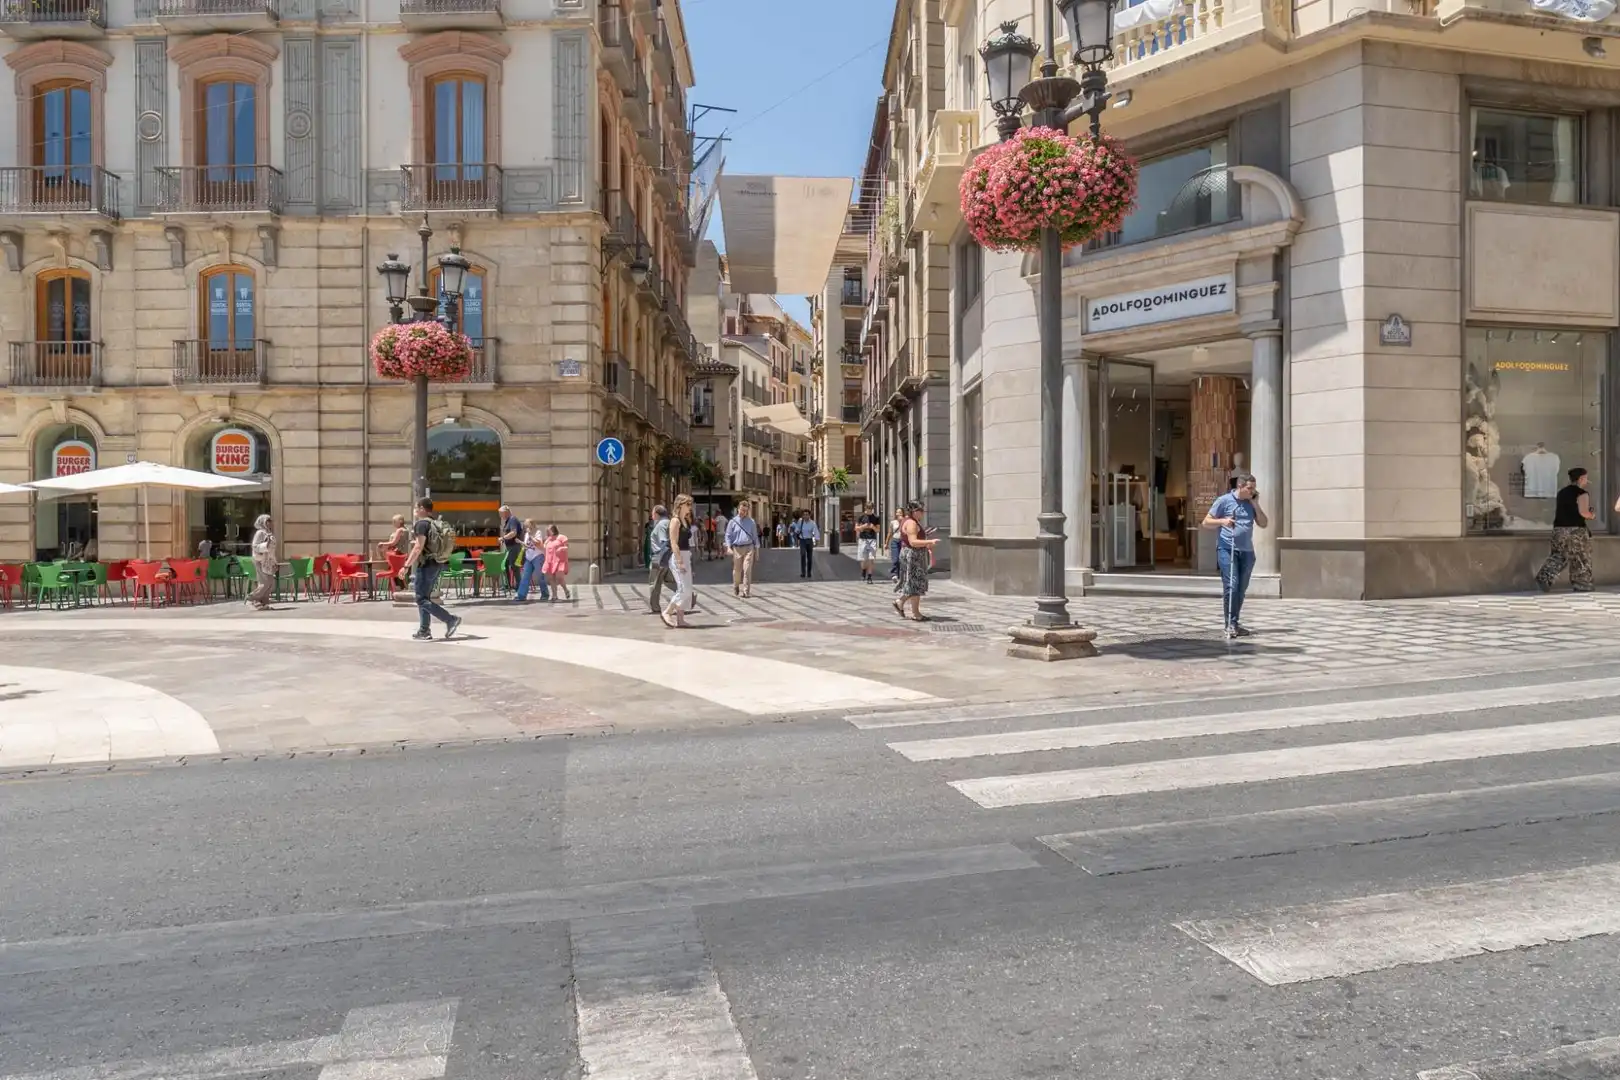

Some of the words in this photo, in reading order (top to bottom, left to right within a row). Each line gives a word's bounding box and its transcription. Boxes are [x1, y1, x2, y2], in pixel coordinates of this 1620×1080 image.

[1092, 283, 1227, 319] ADOLFODOMINGUEZ
[1495, 361, 1568, 371] ADOLFODOMINGUEZ
[216, 445, 249, 453] BURGER
[57, 456, 90, 465] BURGER
[216, 454, 249, 465] KING
